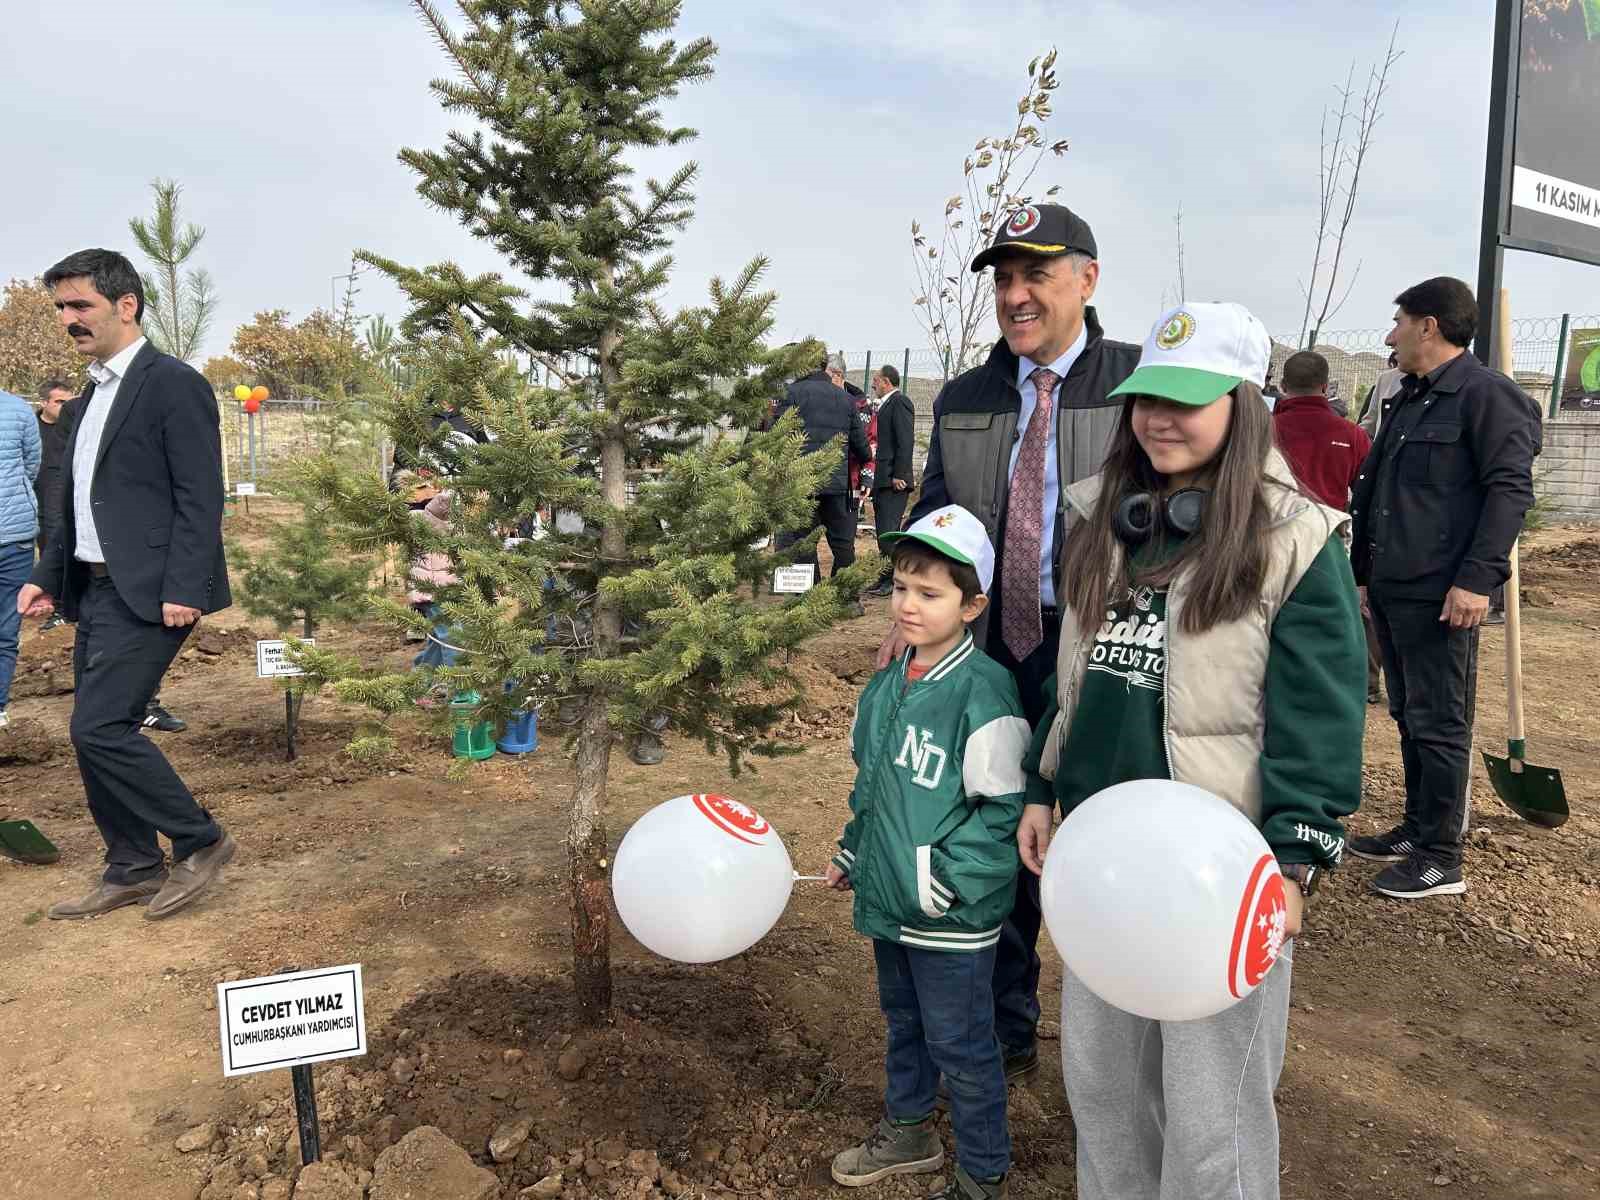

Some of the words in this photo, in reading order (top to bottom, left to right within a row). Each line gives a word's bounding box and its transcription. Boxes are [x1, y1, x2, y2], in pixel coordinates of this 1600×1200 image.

[1535, 182, 1547, 204] 11
[1550, 186, 1591, 216] KASIM
[893, 724, 947, 789] ND
[1293, 822, 1337, 851] Harry
[241, 1000, 292, 1024] CEVDET
[295, 992, 343, 1016] YILMAZ
[233, 1024, 306, 1047] CUMHURBAŞKANI
[307, 1015, 354, 1033] YARDIMCISI
